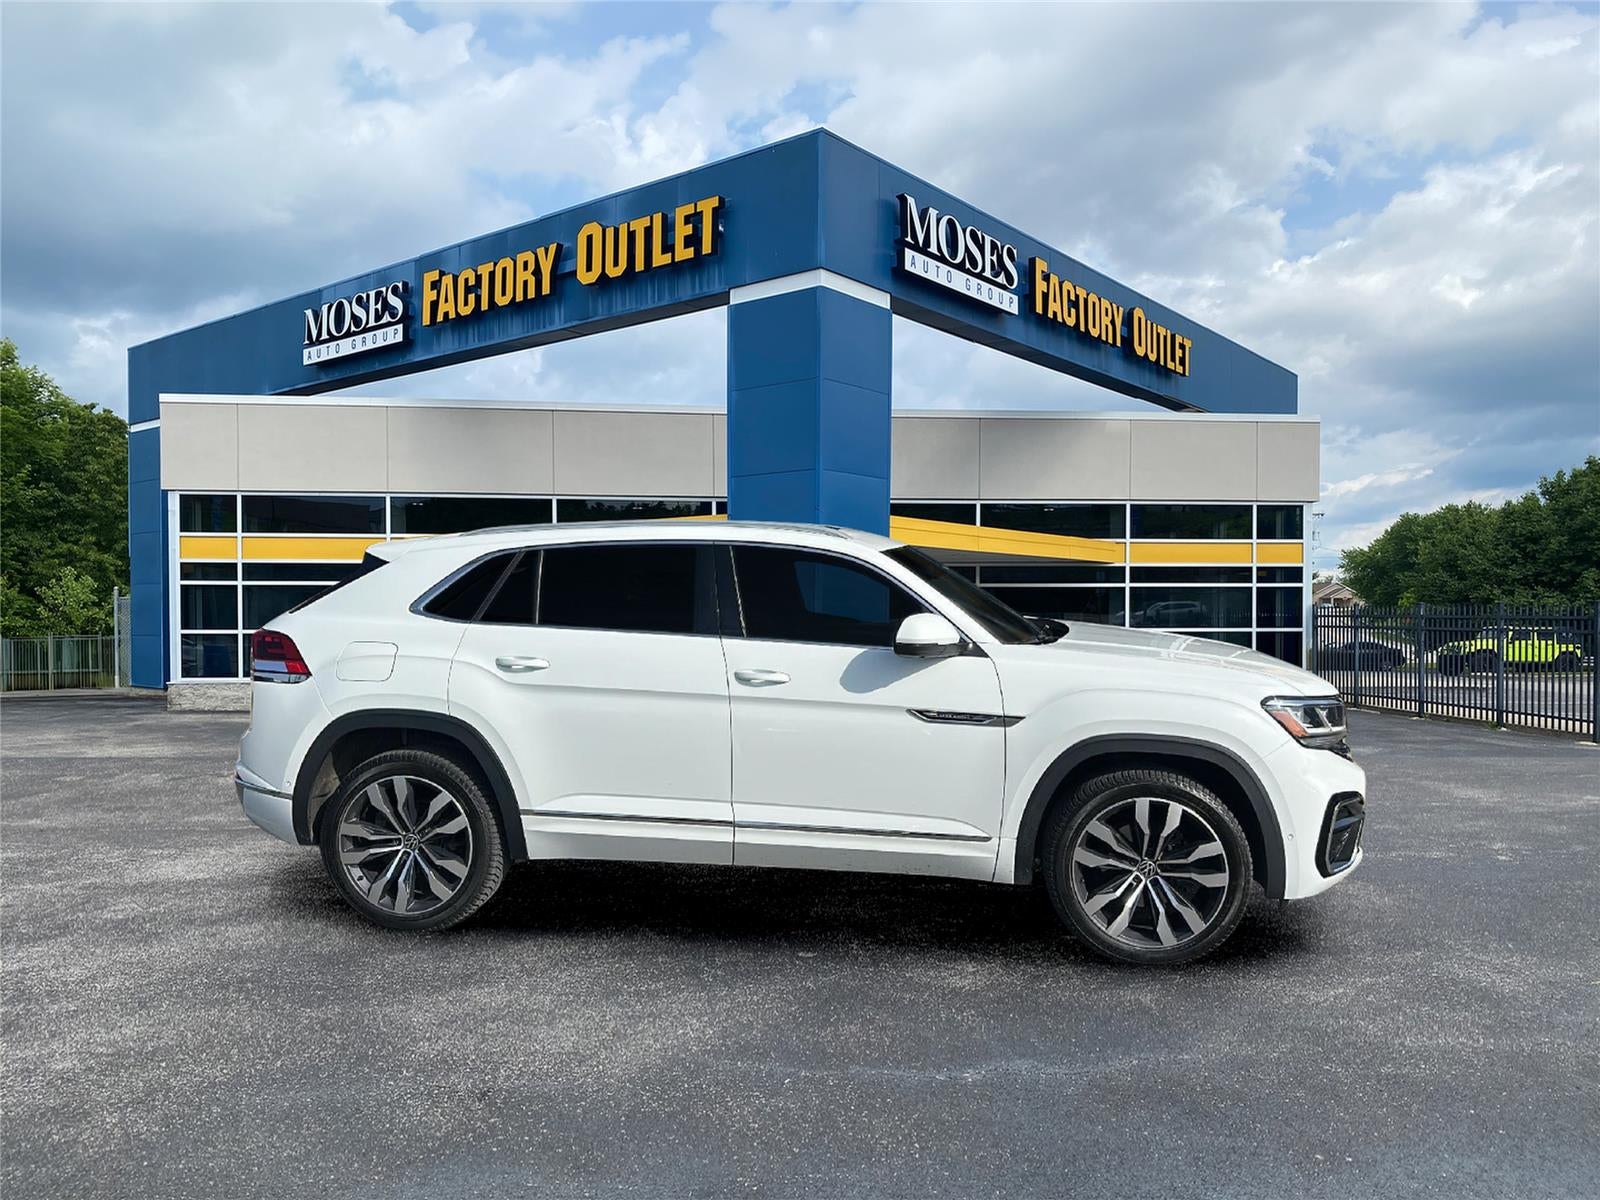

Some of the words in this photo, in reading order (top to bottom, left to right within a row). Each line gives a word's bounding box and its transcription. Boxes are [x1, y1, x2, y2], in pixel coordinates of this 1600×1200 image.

[423, 242, 558, 326] FACTORY
[577, 195, 720, 285] OUTLET
[904, 193, 1019, 289] MOSES
[303, 281, 403, 345] MOSES
[910, 255, 953, 284] AUTO
[965, 278, 1015, 309] GROUP
[1035, 256, 1124, 347] FACTORY
[1133, 308, 1192, 376] OUTLET
[307, 342, 341, 361] AUTO
[351, 328, 399, 350] GROUP
